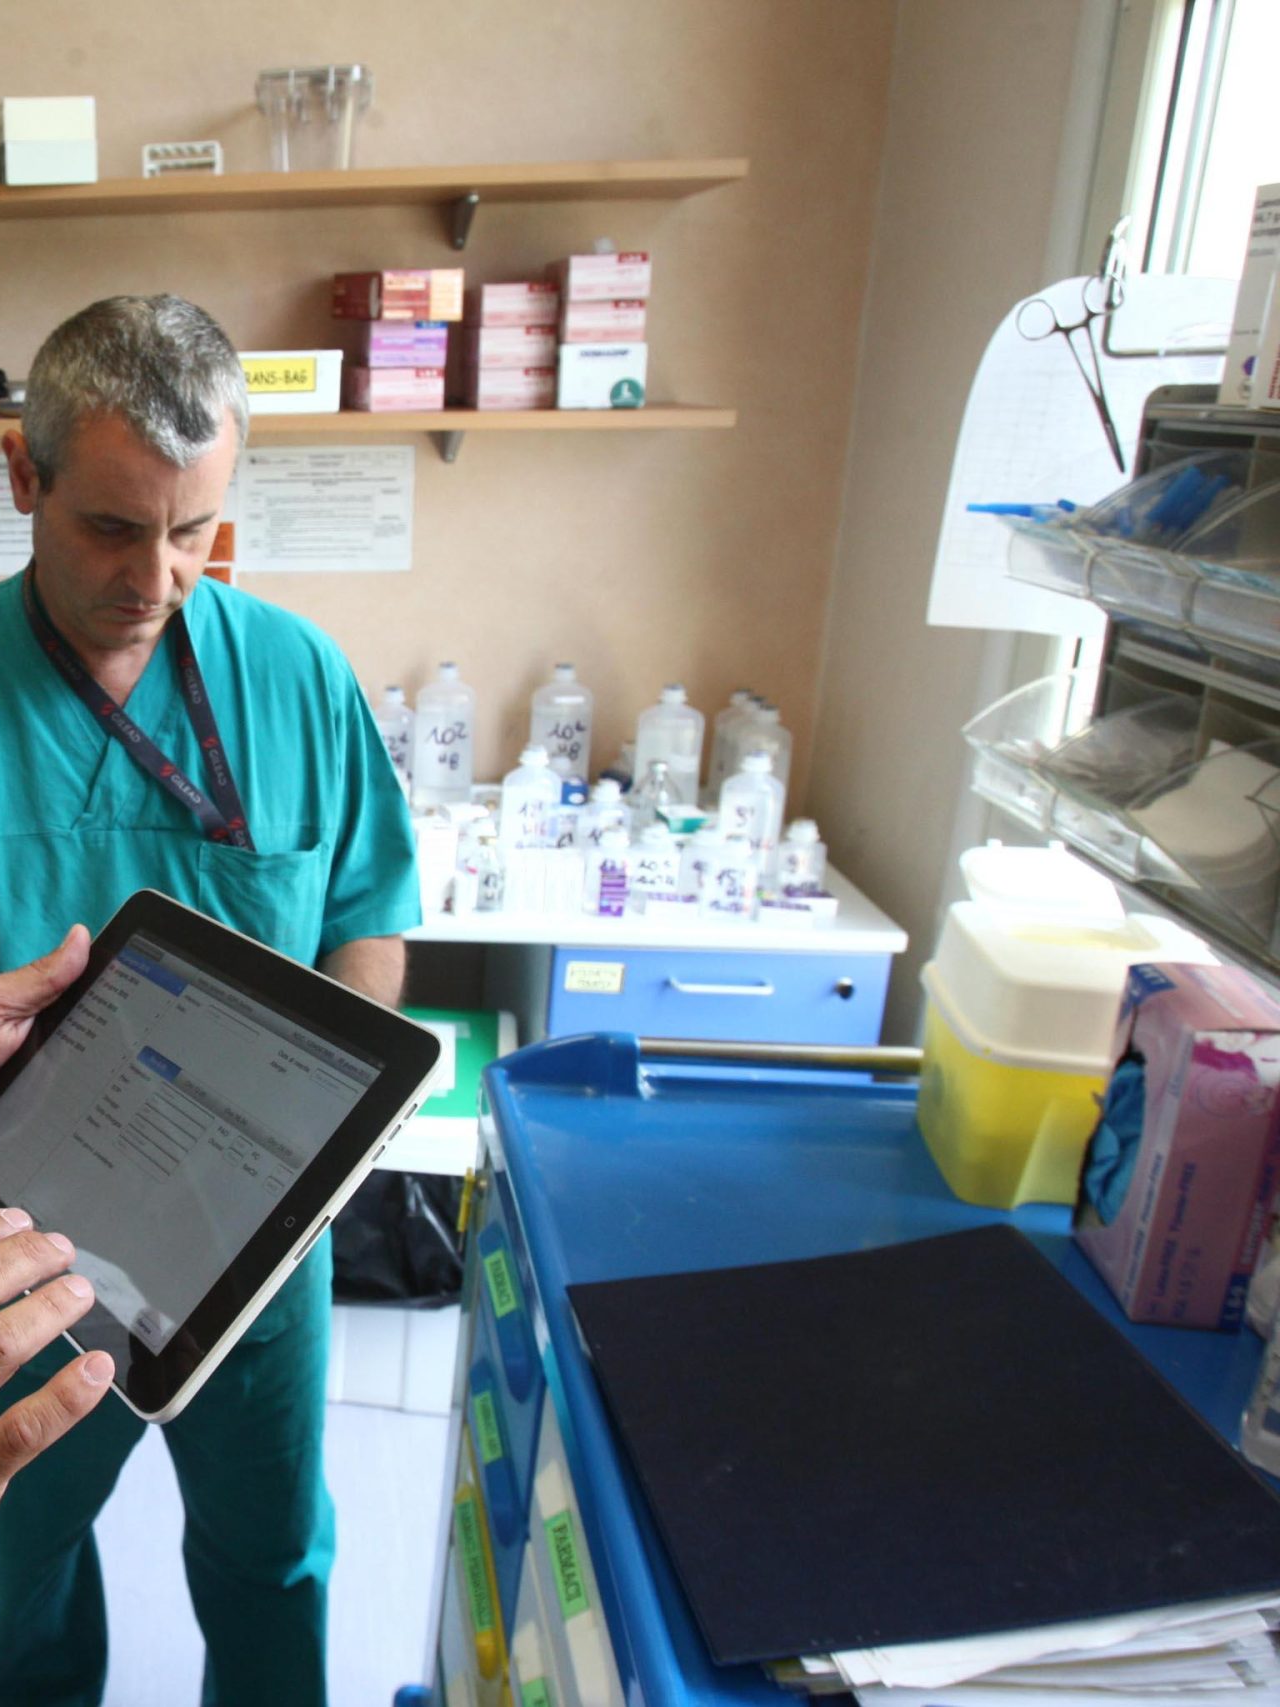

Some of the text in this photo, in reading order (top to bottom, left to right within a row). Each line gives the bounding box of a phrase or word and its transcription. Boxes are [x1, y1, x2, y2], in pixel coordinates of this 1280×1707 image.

[111, 712, 142, 743] GILEAD
[208, 749, 228, 786] GILEAD
[170, 773, 202, 805] GILEAD
[552, 1523, 582, 1604] FARMACI
